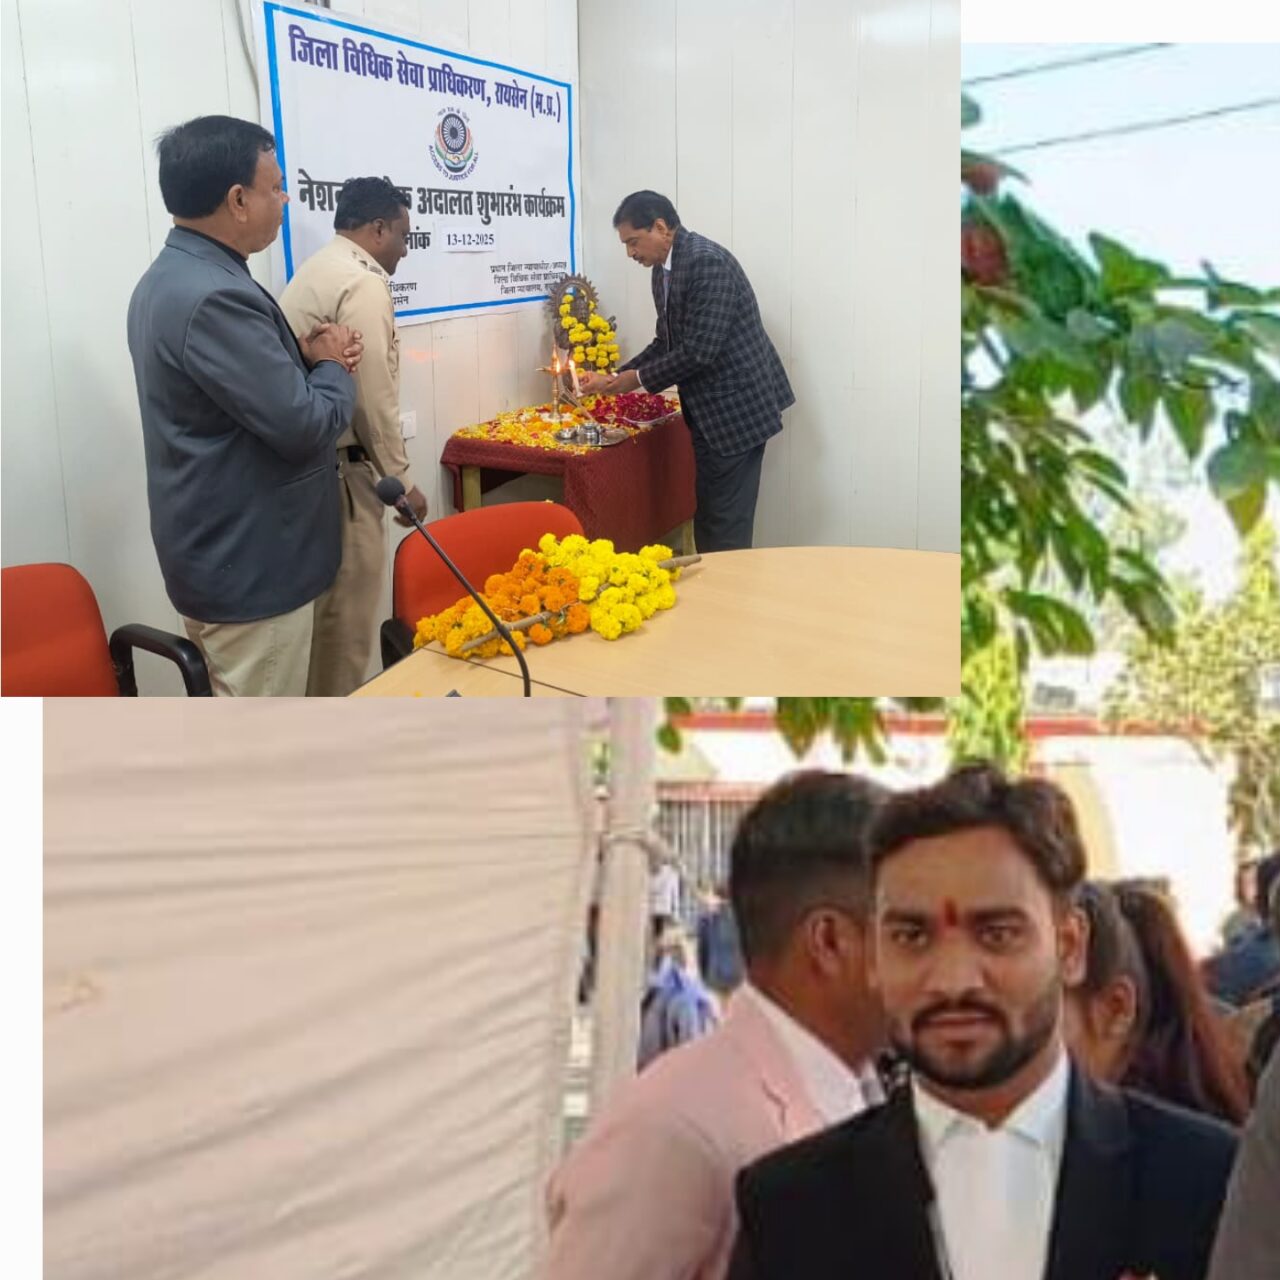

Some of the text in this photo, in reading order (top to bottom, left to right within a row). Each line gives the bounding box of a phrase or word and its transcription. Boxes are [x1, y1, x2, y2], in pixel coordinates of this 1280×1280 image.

[288, 23, 561, 123] जिला विधिक सेवा प्राधिकरण, रायसेन (म.प्र.)
[417, 186, 474, 216] अदालत
[476, 184, 522, 226] शुभारंभ
[524, 187, 566, 218] कार्यक्रम
[405, 225, 495, 249] नांक 13-12-2025
[388, 280, 417, 293] धिकरण
